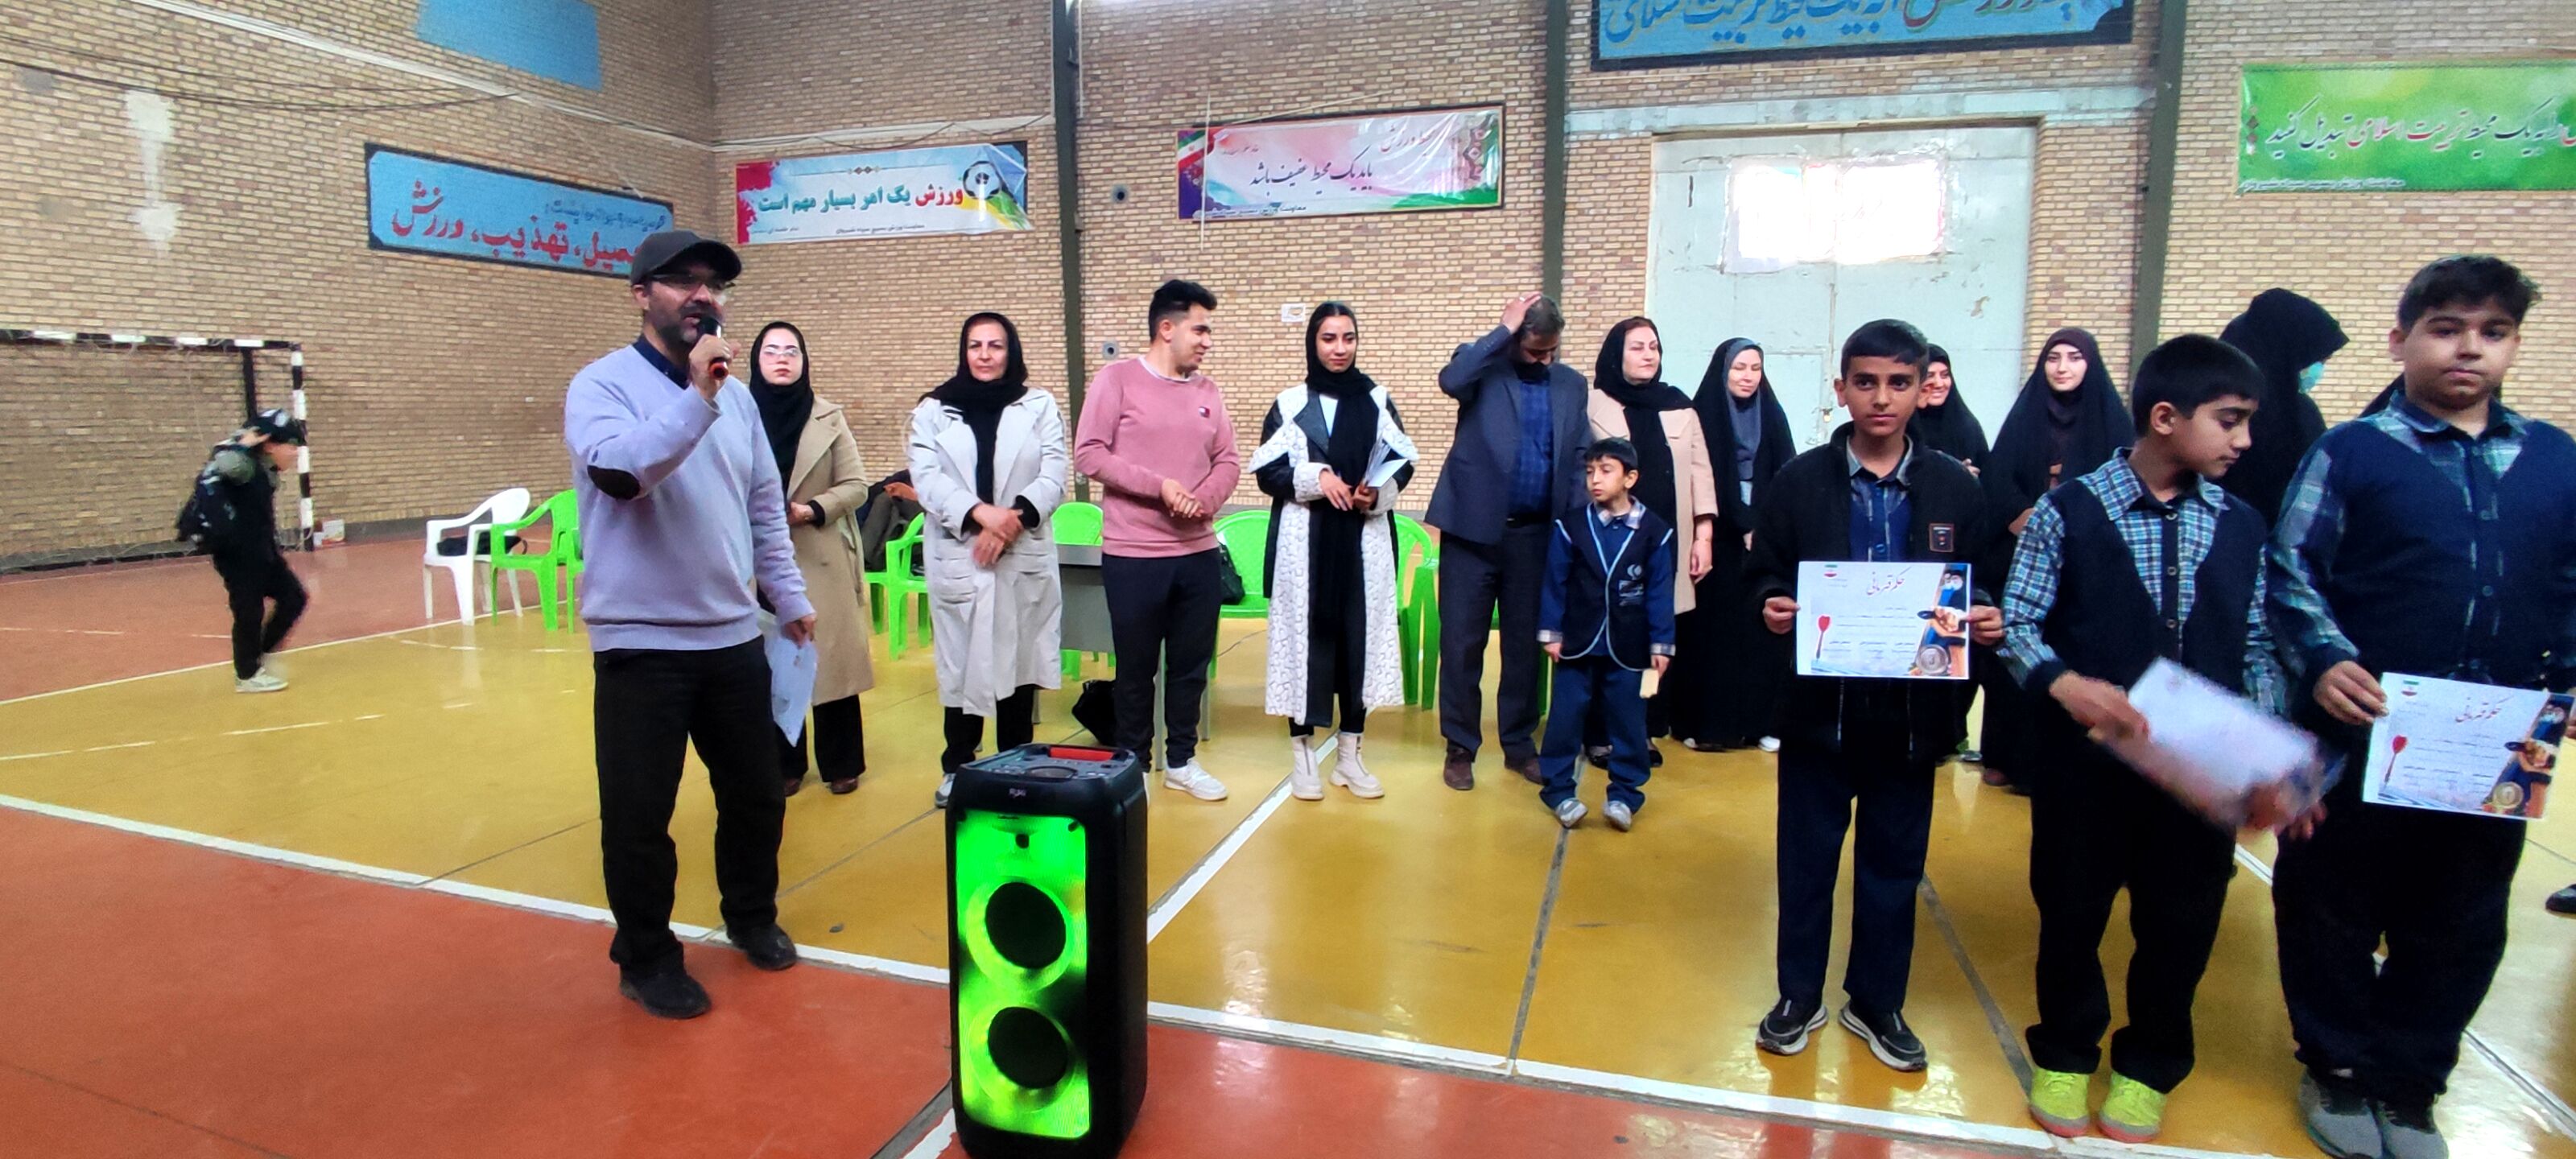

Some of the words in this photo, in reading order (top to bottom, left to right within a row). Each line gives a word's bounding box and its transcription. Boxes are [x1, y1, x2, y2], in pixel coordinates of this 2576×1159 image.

[2265, 94, 2322, 159] کنید
[2299, 113, 2353, 159] تبدیل
[1249, 162, 1271, 197] باشد
[1270, 158, 1308, 188] عفیف
[1310, 162, 1332, 195] محیط
[1329, 144, 1372, 192] یک
[1356, 160, 1373, 192] باید
[391, 179, 464, 239] ورزش
[757, 192, 789, 212] است
[791, 195, 816, 214] مهم
[819, 189, 857, 213] بسیار
[860, 186, 884, 211] امر
[886, 184, 911, 207] یک
[914, 184, 964, 206] ورزش
